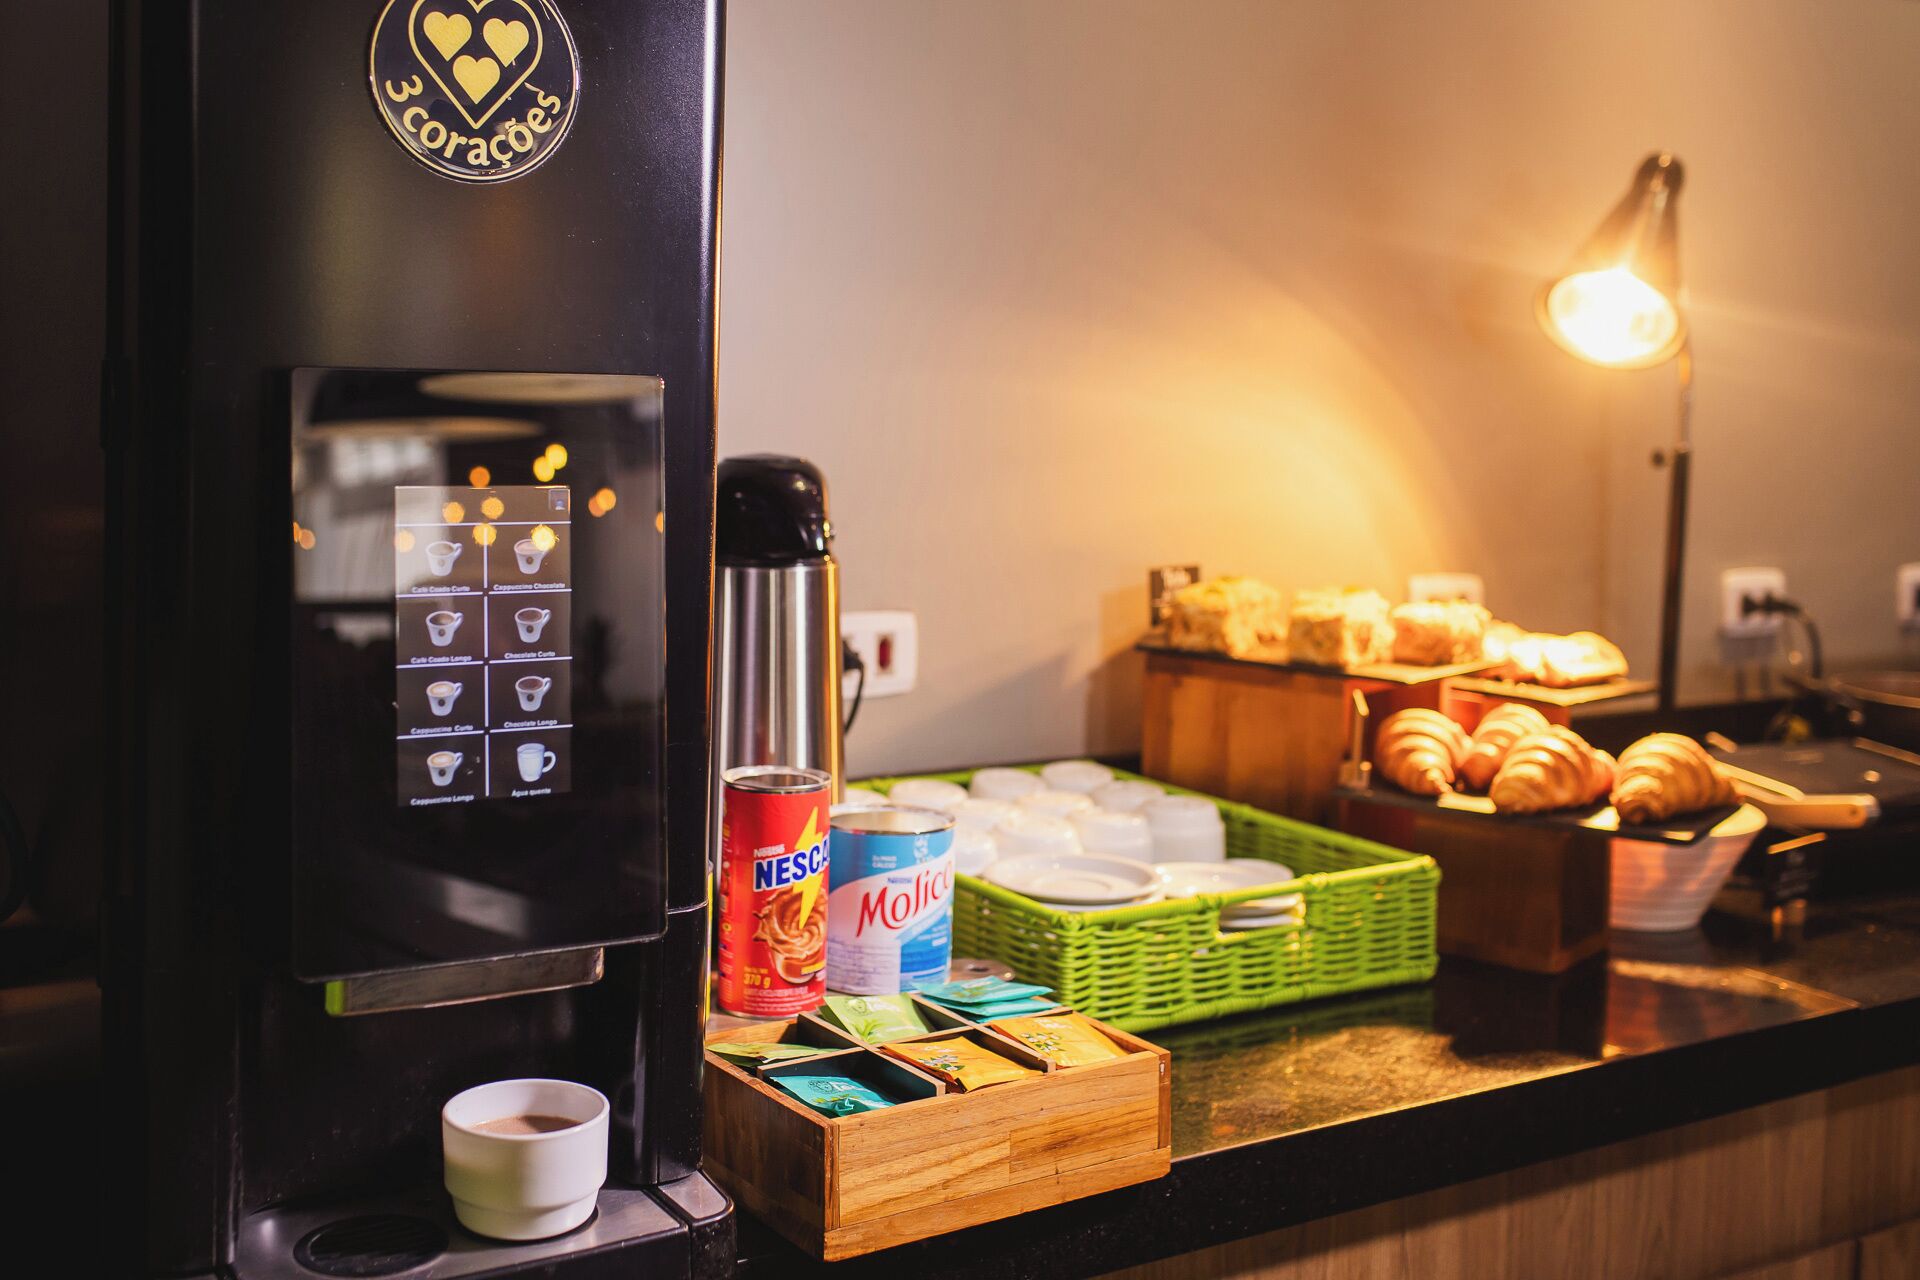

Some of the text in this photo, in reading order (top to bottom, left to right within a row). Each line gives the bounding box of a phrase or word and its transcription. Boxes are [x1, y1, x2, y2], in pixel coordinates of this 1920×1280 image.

[385, 74, 562, 169] 3 corações
[493, 582, 566, 591] Cappuccino Chocolate
[504, 650, 556, 660] Chocolate Curto
[504, 718, 558, 729] Chocolate Longo
[410, 726, 452, 736] Cappuccino
